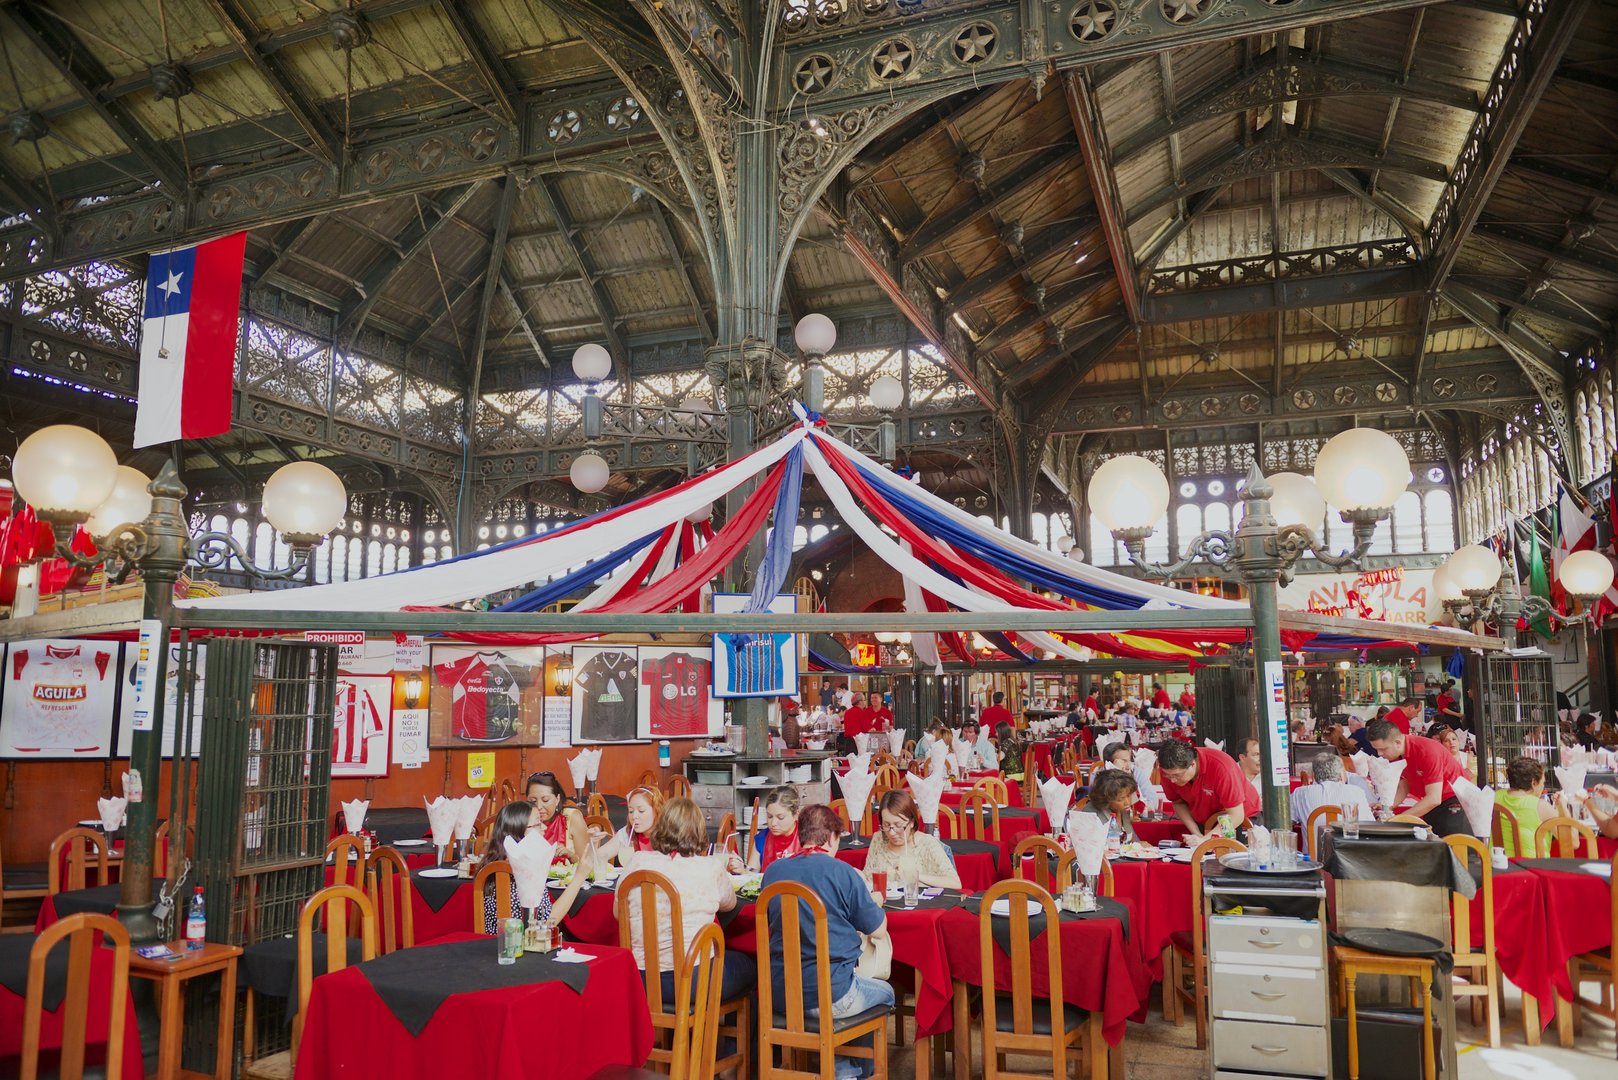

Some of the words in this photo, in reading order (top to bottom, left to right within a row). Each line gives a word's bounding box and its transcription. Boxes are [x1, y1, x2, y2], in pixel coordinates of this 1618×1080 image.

[307, 634, 363, 643] PROHIBIDO
[35, 686, 84, 699] AGUILA
[680, 685, 697, 697] LG
